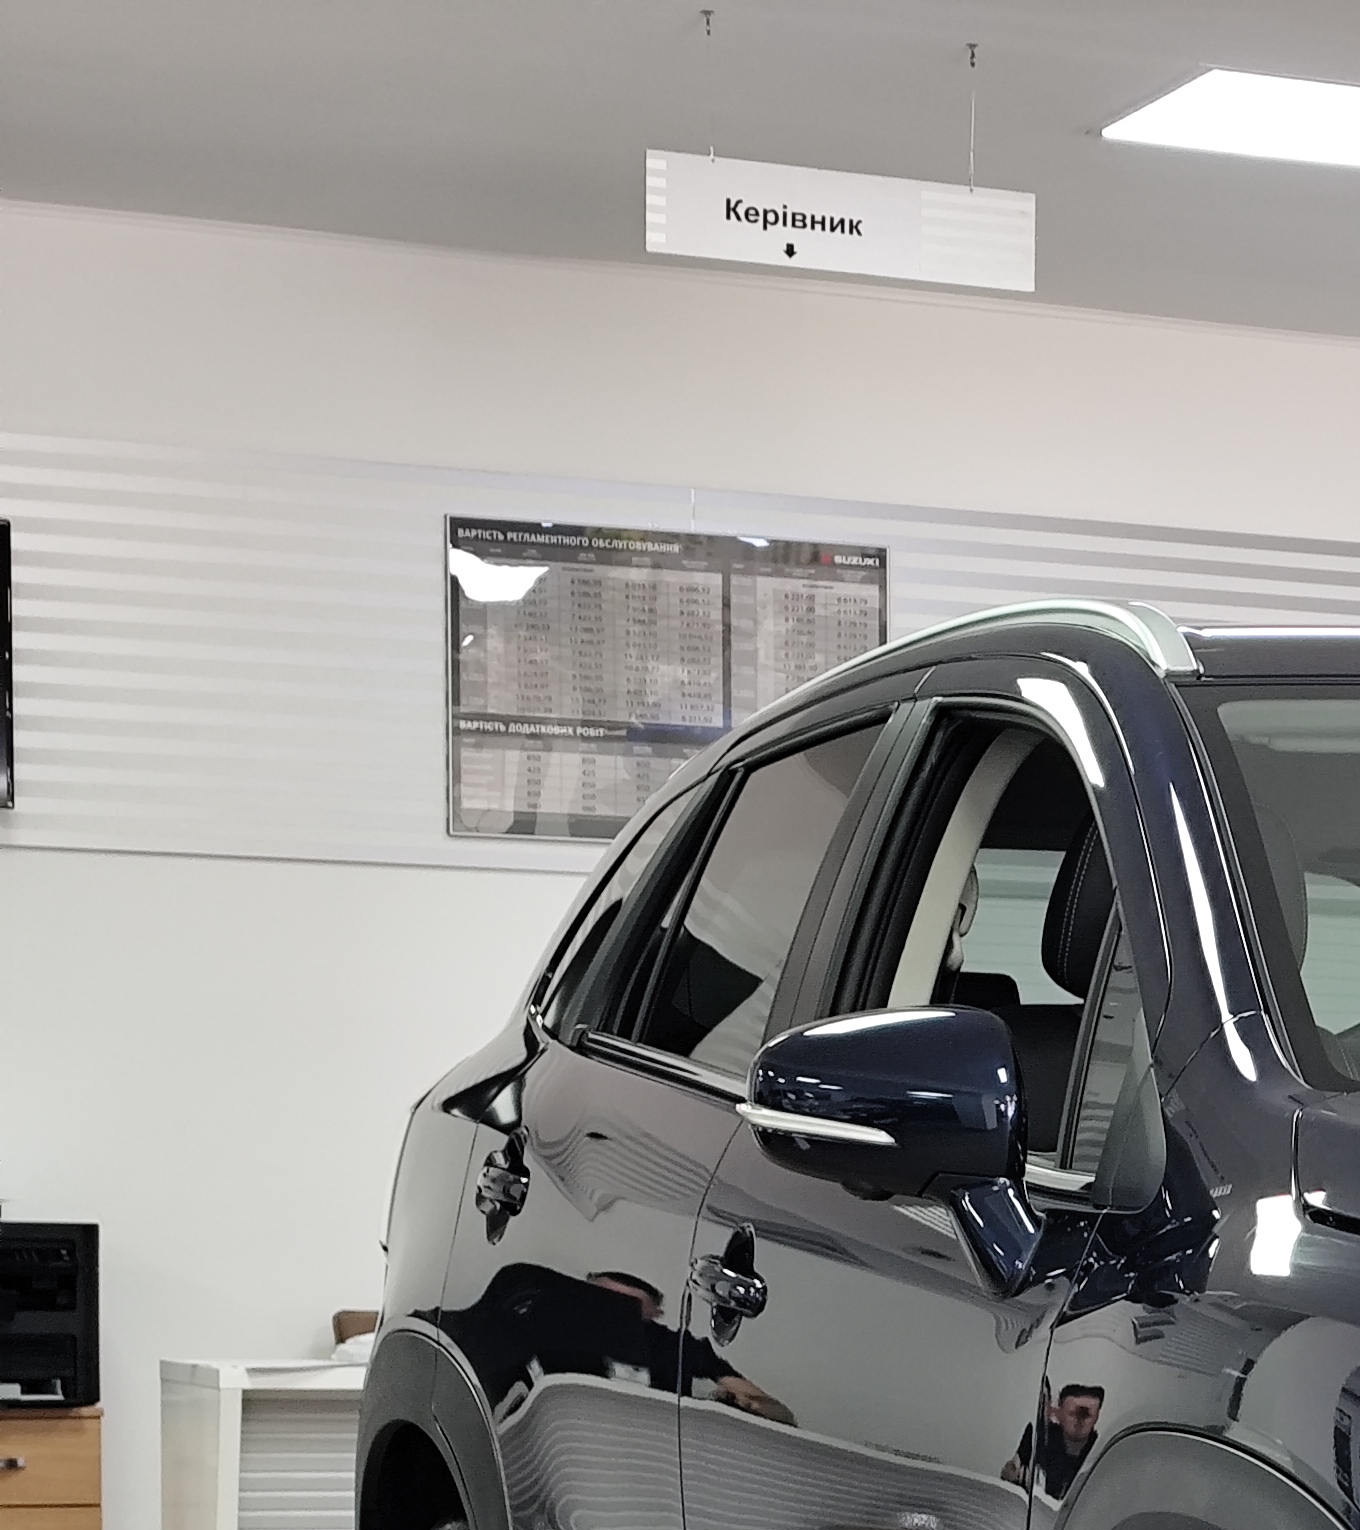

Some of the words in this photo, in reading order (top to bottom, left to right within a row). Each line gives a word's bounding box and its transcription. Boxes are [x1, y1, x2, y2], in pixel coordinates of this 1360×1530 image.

[724, 197, 863, 236] Керівник
[457, 527, 505, 541] ВАРТІСТЬ
[506, 531, 589, 547] РЕГЛАМЕНТНОГО
[834, 555, 880, 568] SUZUKI
[459, 720, 506, 732] ВАРТІСТЬ
[508, 722, 573, 736] ДОДАТКОВИХ
[576, 726, 606, 738] РОБІТ
